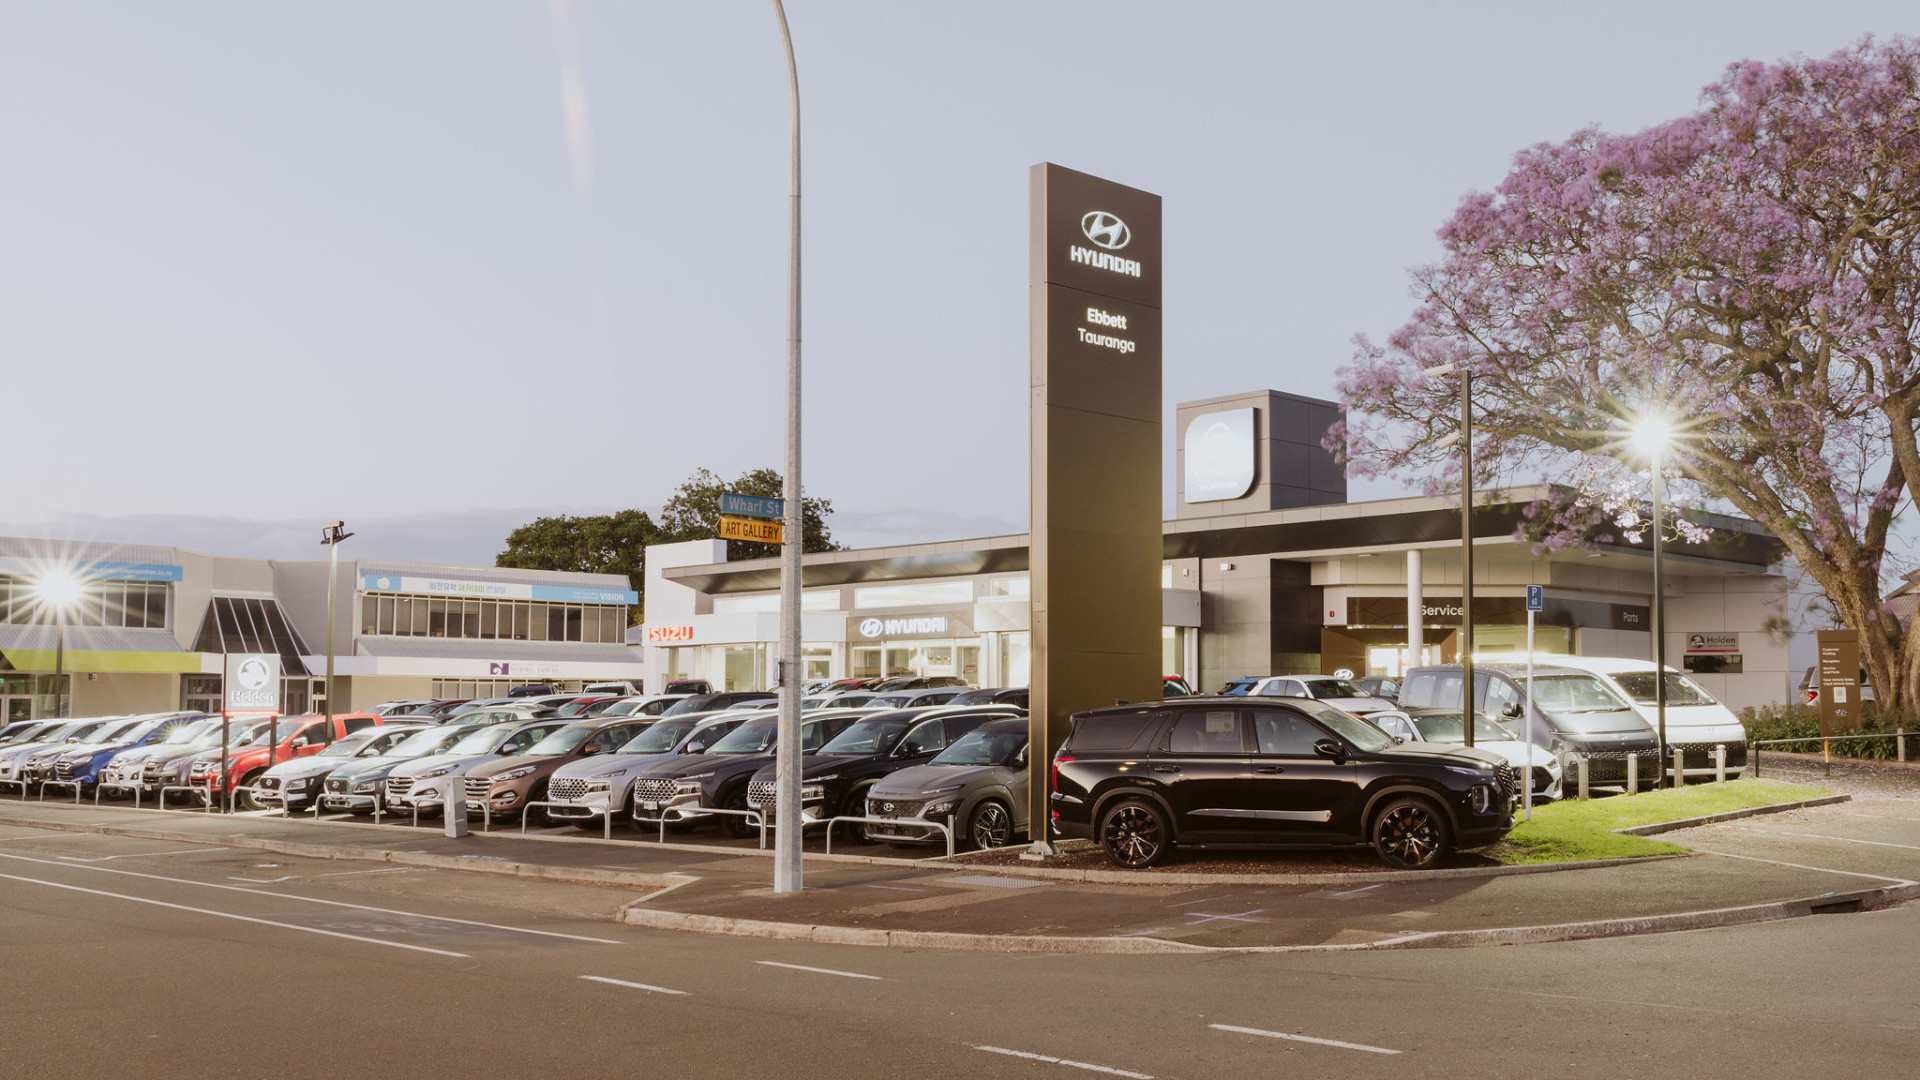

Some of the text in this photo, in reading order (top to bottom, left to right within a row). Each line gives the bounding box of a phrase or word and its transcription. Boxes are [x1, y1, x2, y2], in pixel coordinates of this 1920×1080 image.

[1071, 245, 1141, 277] HYUNDAI
[1087, 308, 1127, 329] Ebbett
[1078, 328, 1135, 353] Tauranga
[728, 496, 780, 514] Wharf St
[726, 521, 779, 540] ART GALLERY
[600, 592, 625, 601] VISION
[1531, 587, 1538, 597] P
[1422, 604, 1464, 616] Service
[1623, 611, 1639, 623] Parts
[884, 616, 946, 635] HYUNDAI
[1706, 636, 1736, 644] Holden
[231, 690, 275, 702] Holden
